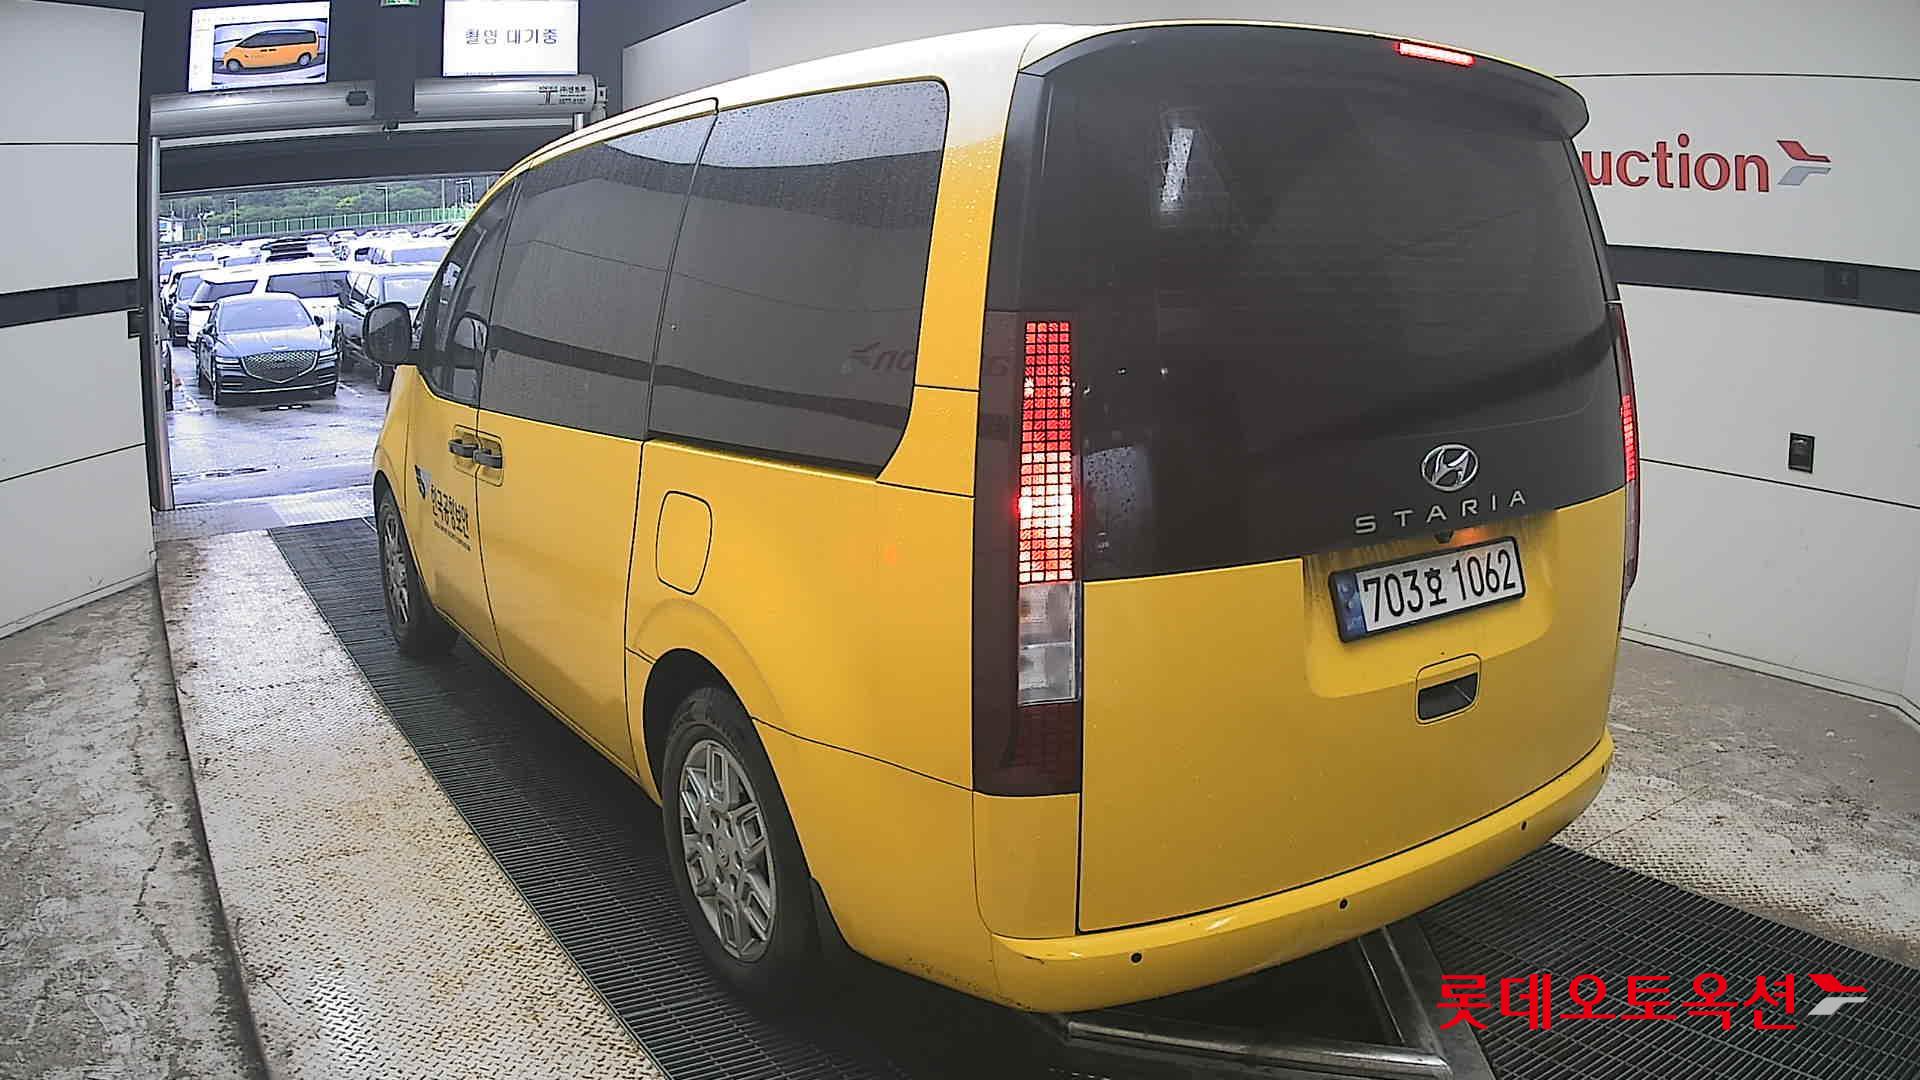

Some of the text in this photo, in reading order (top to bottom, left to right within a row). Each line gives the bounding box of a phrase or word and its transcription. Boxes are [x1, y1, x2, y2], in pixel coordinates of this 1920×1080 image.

[506, 28, 558, 45] 대기중
[1355, 490, 1526, 534] STARIA
[1363, 549, 1516, 623] 703호 1062
